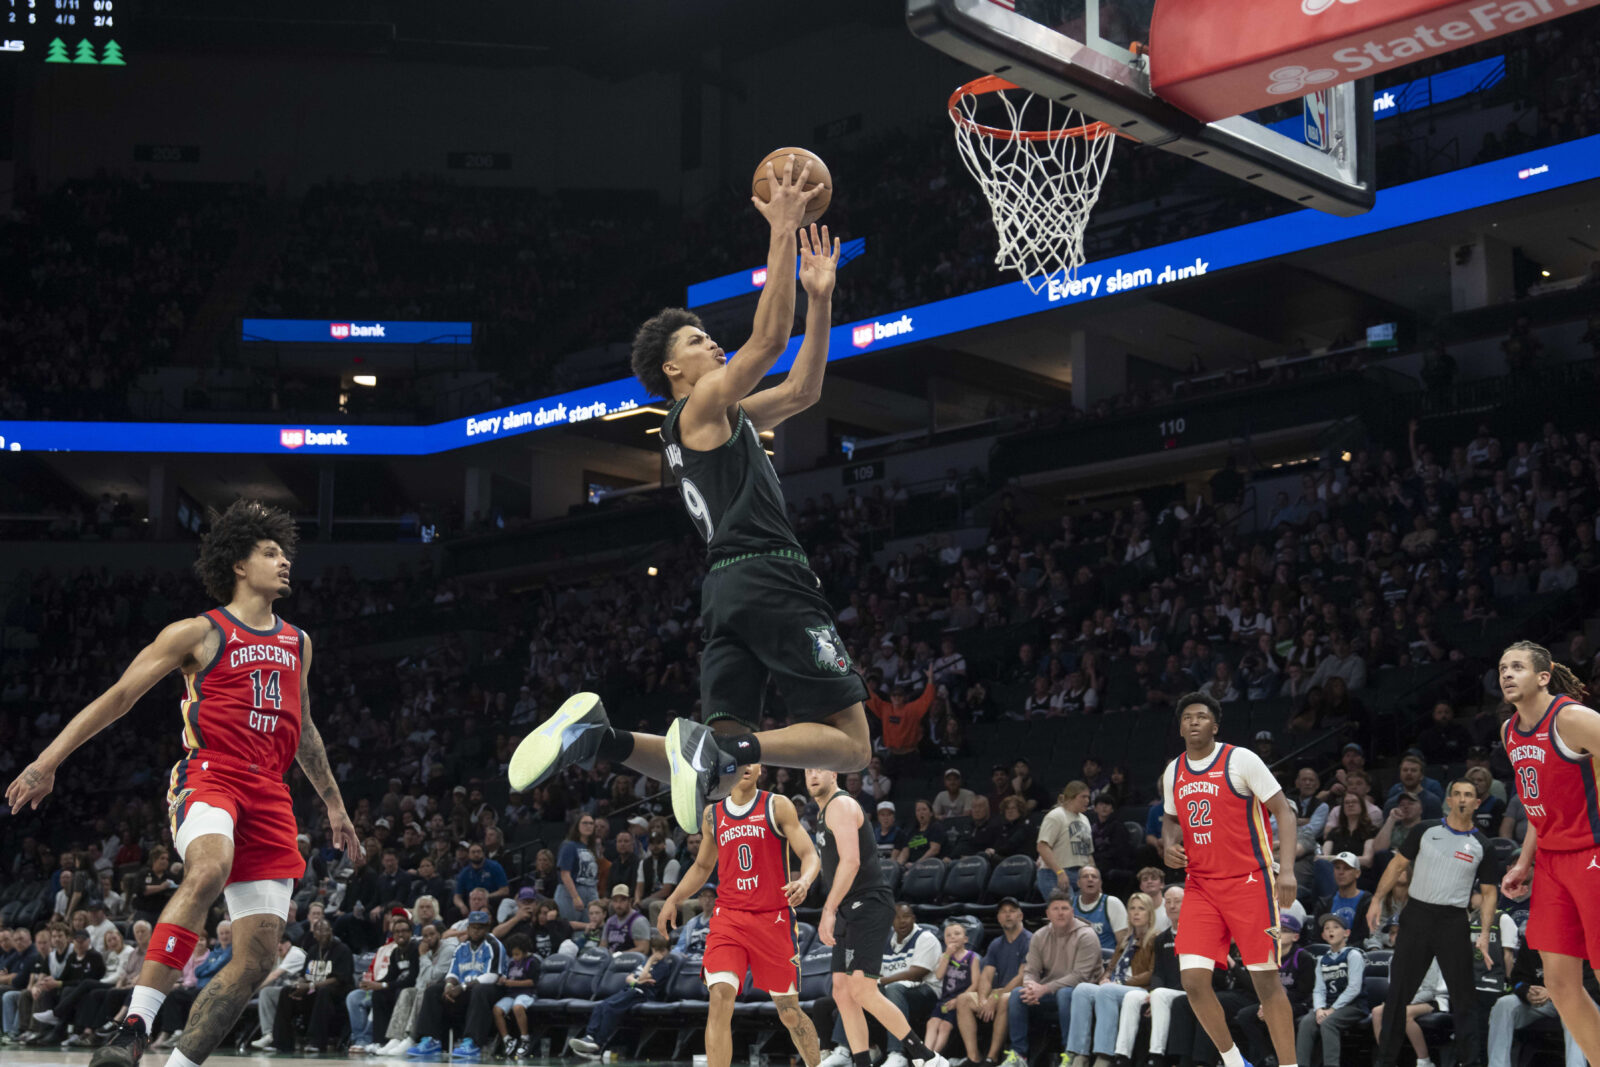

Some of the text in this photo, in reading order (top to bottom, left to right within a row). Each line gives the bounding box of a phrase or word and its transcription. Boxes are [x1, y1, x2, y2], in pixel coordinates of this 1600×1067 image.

[93, 0, 113, 11] 0/0
[9, 12, 16, 23] 2
[94, 15, 113, 27] 2/4
[1048, 275, 1102, 301] Every
[1106, 268, 1152, 292] slam
[350, 323, 386, 337] bank
[874, 314, 914, 340] bank
[466, 416, 502, 437] Every
[502, 411, 533, 430] slam
[534, 402, 567, 426] dunk
[568, 400, 607, 423] starts
[1158, 418, 1186, 436] 110
[305, 429, 348, 446] bank
[852, 465, 874, 481] 109
[681, 477, 715, 544] 9
[230, 644, 297, 671] CRESCENT
[250, 668, 282, 710] 14
[249, 710, 279, 733] CITY
[1178, 781, 1220, 800] CRESCENT
[1517, 766, 1539, 799] 13
[1187, 798, 1213, 827] 22
[1524, 803, 1547, 817] CITY
[720, 824, 766, 847] CRESCENT
[1193, 831, 1212, 845] CITY
[738, 843, 753, 872] 0
[736, 874, 759, 891] CITY
